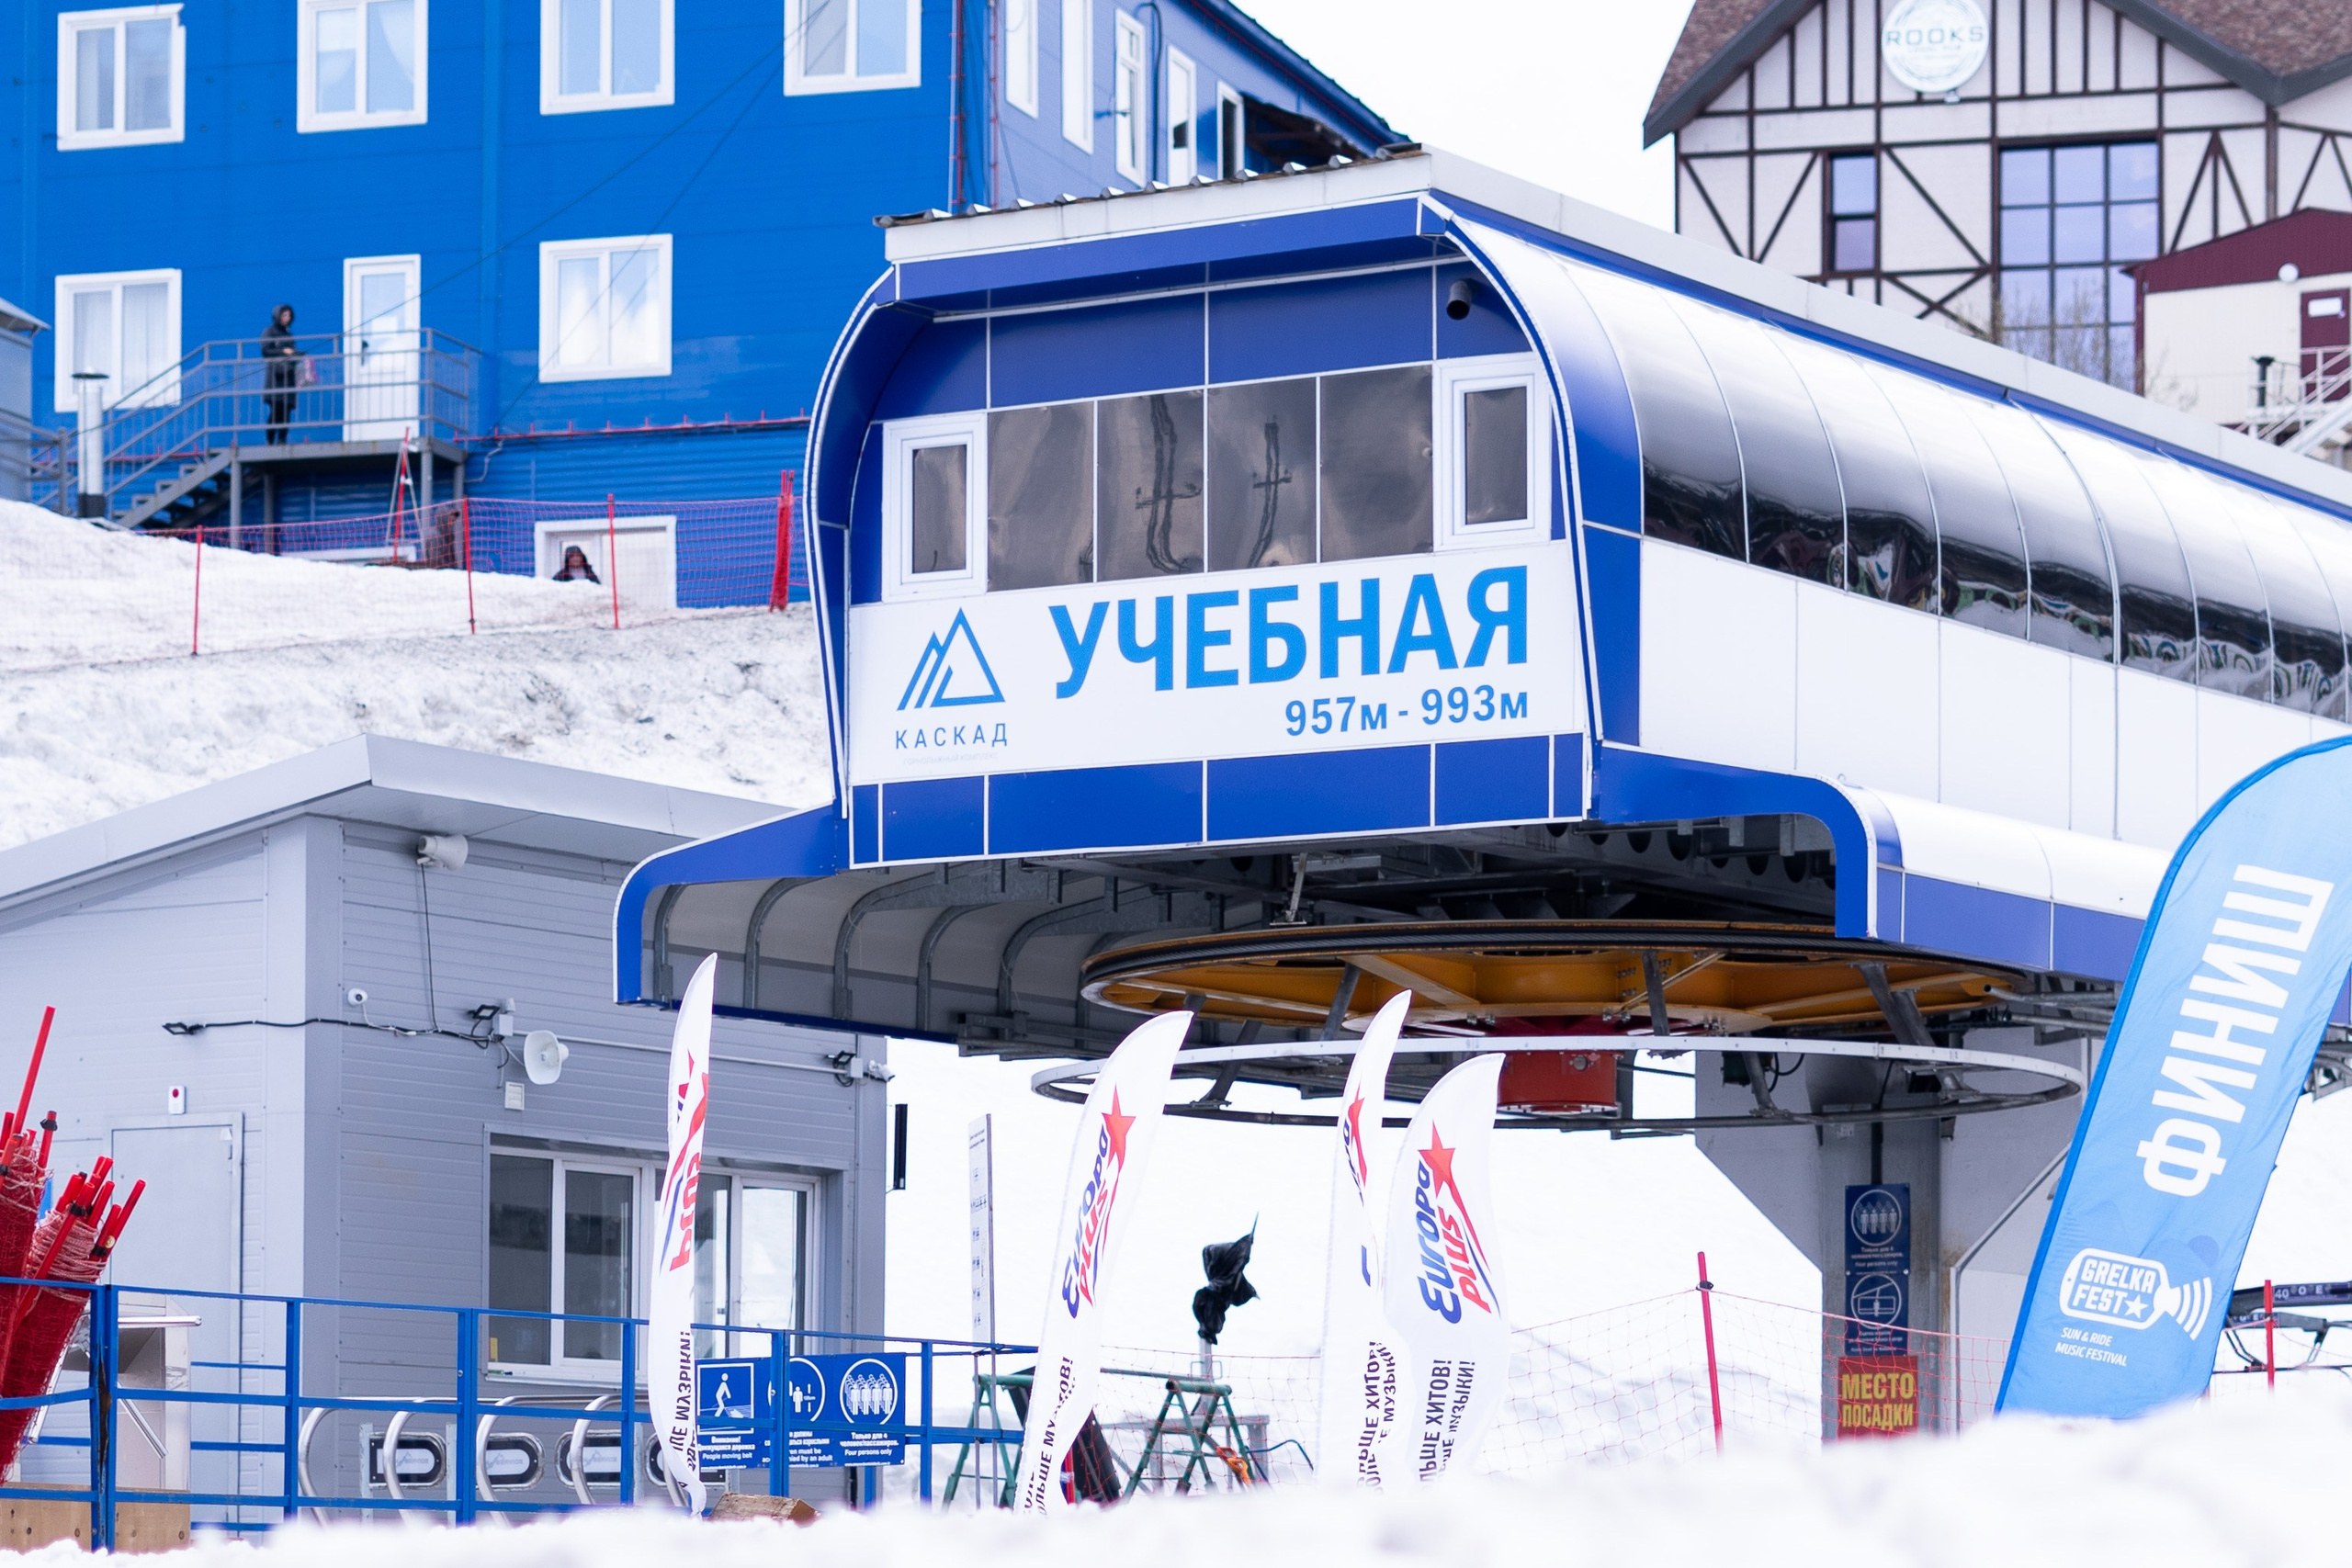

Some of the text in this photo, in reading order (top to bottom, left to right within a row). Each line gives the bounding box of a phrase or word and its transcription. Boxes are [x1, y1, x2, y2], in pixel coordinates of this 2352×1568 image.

[1886, 26, 1984, 45] ROOKS
[1048, 565, 1528, 699] УЧЕБНАЯ
[1285, 696, 1387, 736] 957м
[1420, 684, 1529, 725] 993м
[896, 723, 1008, 750] КАСКАД
[2136, 864, 2335, 1197] ФИНИШ
[1062, 1123, 1110, 1319] Europa
[1416, 1160, 1462, 1324] Europa
[1080, 1181, 1110, 1307] plus
[1439, 1206, 1492, 1314] plus
[2081, 1258, 2156, 1293] GRELKA
[2072, 1283, 2128, 1314] FEST
[2055, 1342, 2128, 1366] MUSIC FESTIVAL
[2060, 1327, 2113, 1347] SUN & RIDE
[1425, 1359, 1452, 1426] ХИТОВ!
[1842, 1372, 1914, 1400] МЕСТО
[1842, 1404, 1914, 1429] ПОСАДКИ
